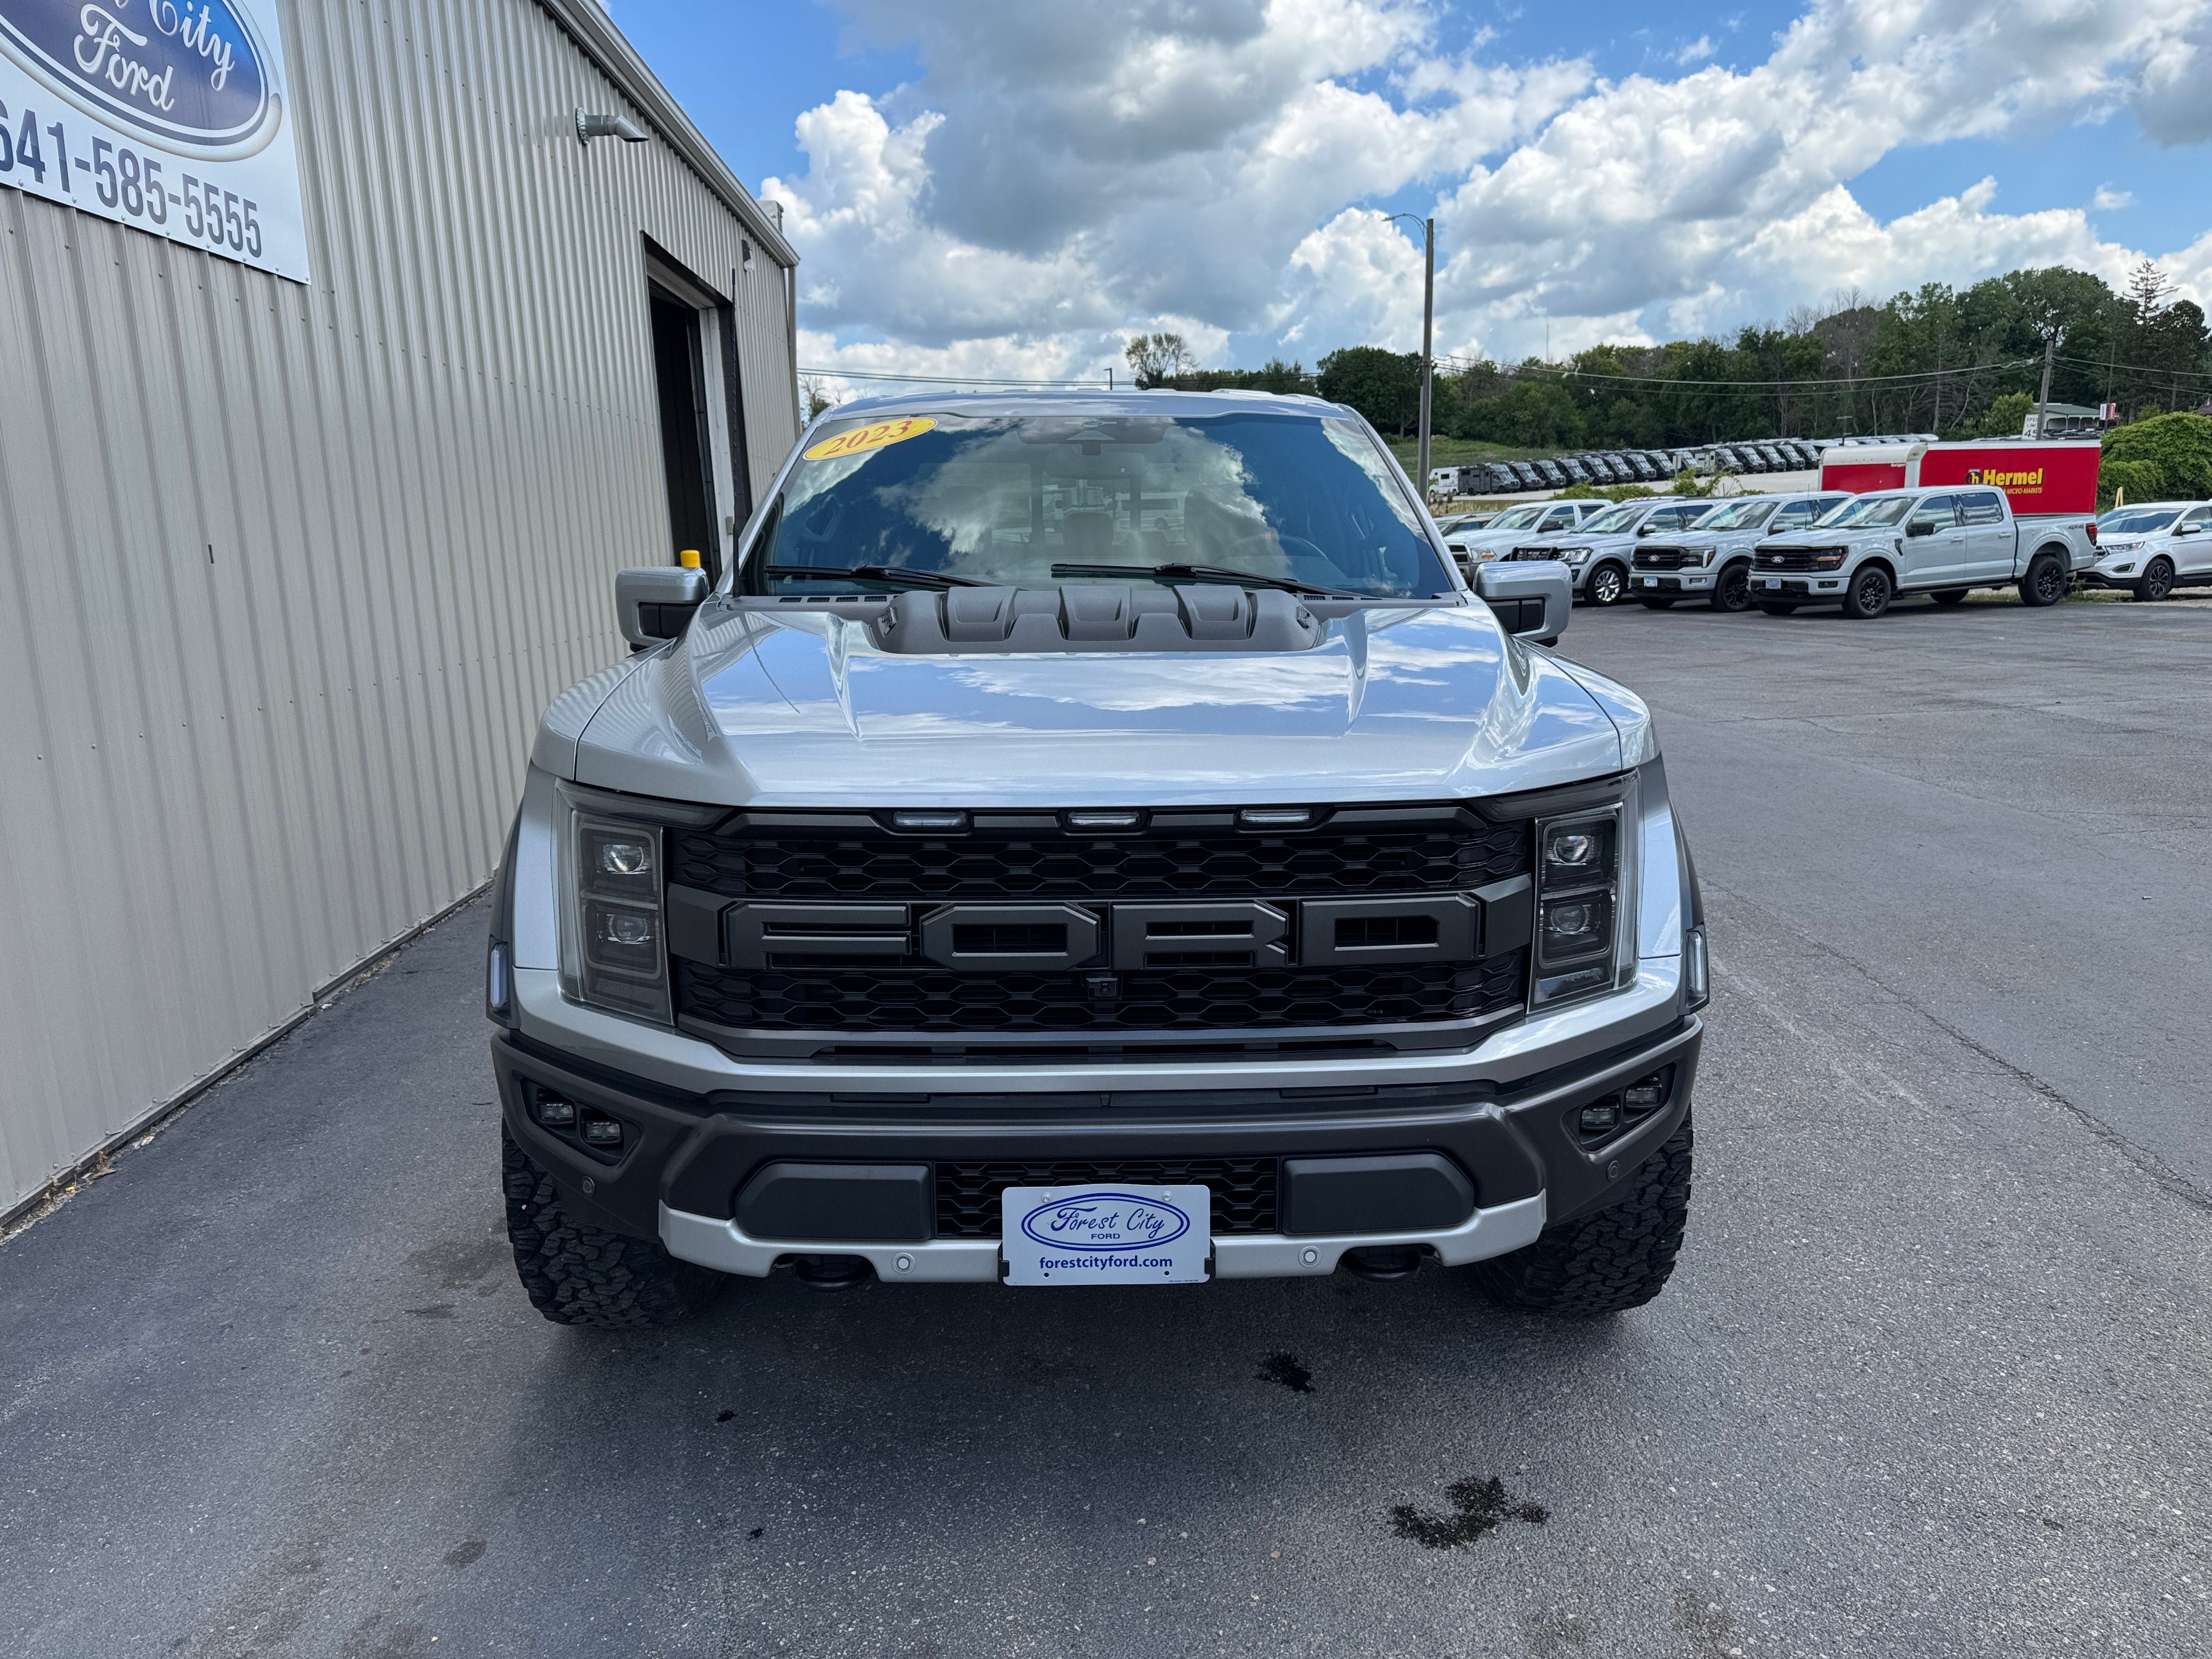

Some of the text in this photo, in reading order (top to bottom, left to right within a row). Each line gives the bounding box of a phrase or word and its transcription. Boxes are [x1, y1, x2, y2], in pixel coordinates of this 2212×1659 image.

[74, 4, 174, 111] Ford
[822, 420, 912, 456] 2023
[1983, 468, 2043, 486] Hermel
[723, 894, 1478, 972] FORD
[1051, 1207, 1165, 1239] Forest City
[1040, 1255, 1172, 1271] forestcityford.com
